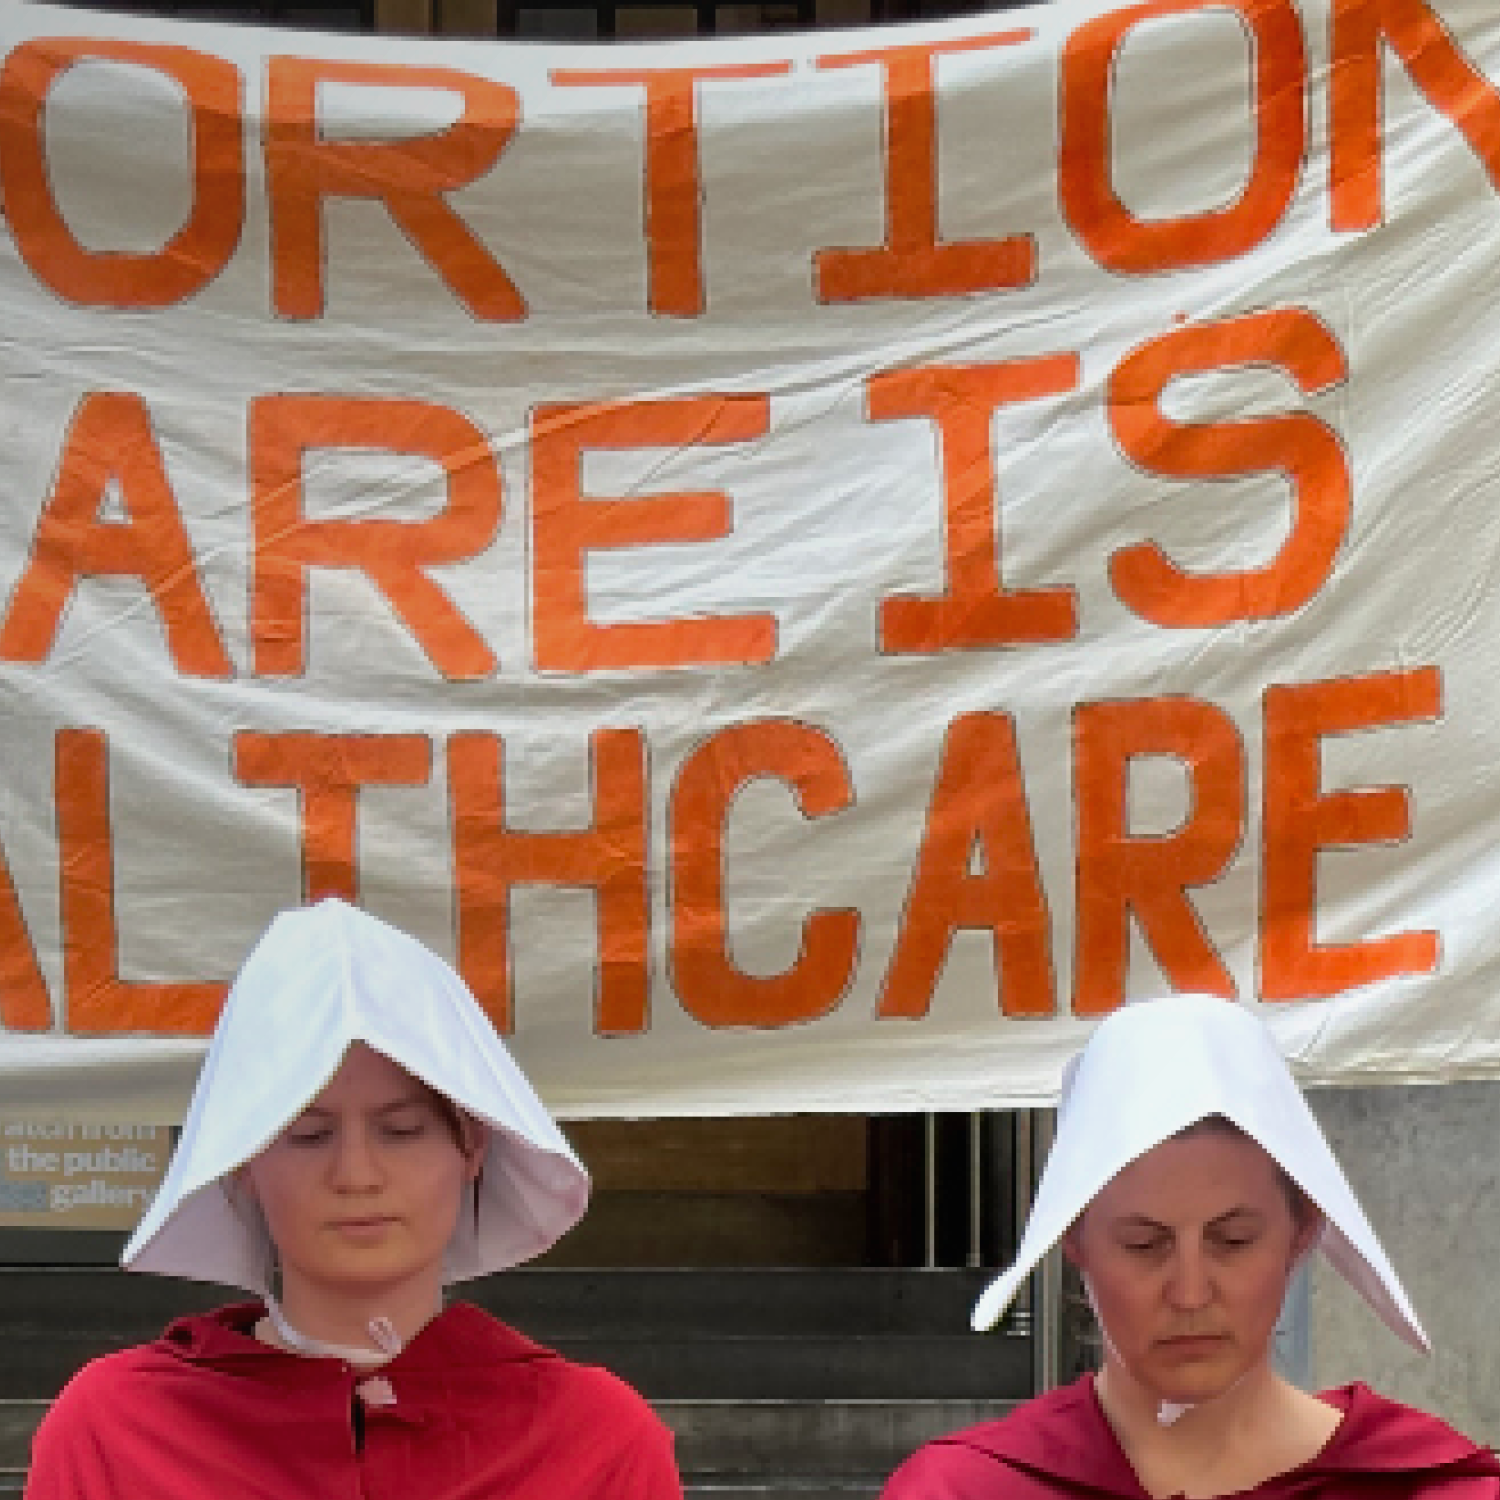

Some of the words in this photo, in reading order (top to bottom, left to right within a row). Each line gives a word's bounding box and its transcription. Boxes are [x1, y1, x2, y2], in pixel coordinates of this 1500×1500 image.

[866, 307, 1353, 656] IS
[7, 1143, 60, 1172] the
[62, 1146, 157, 1177] public
